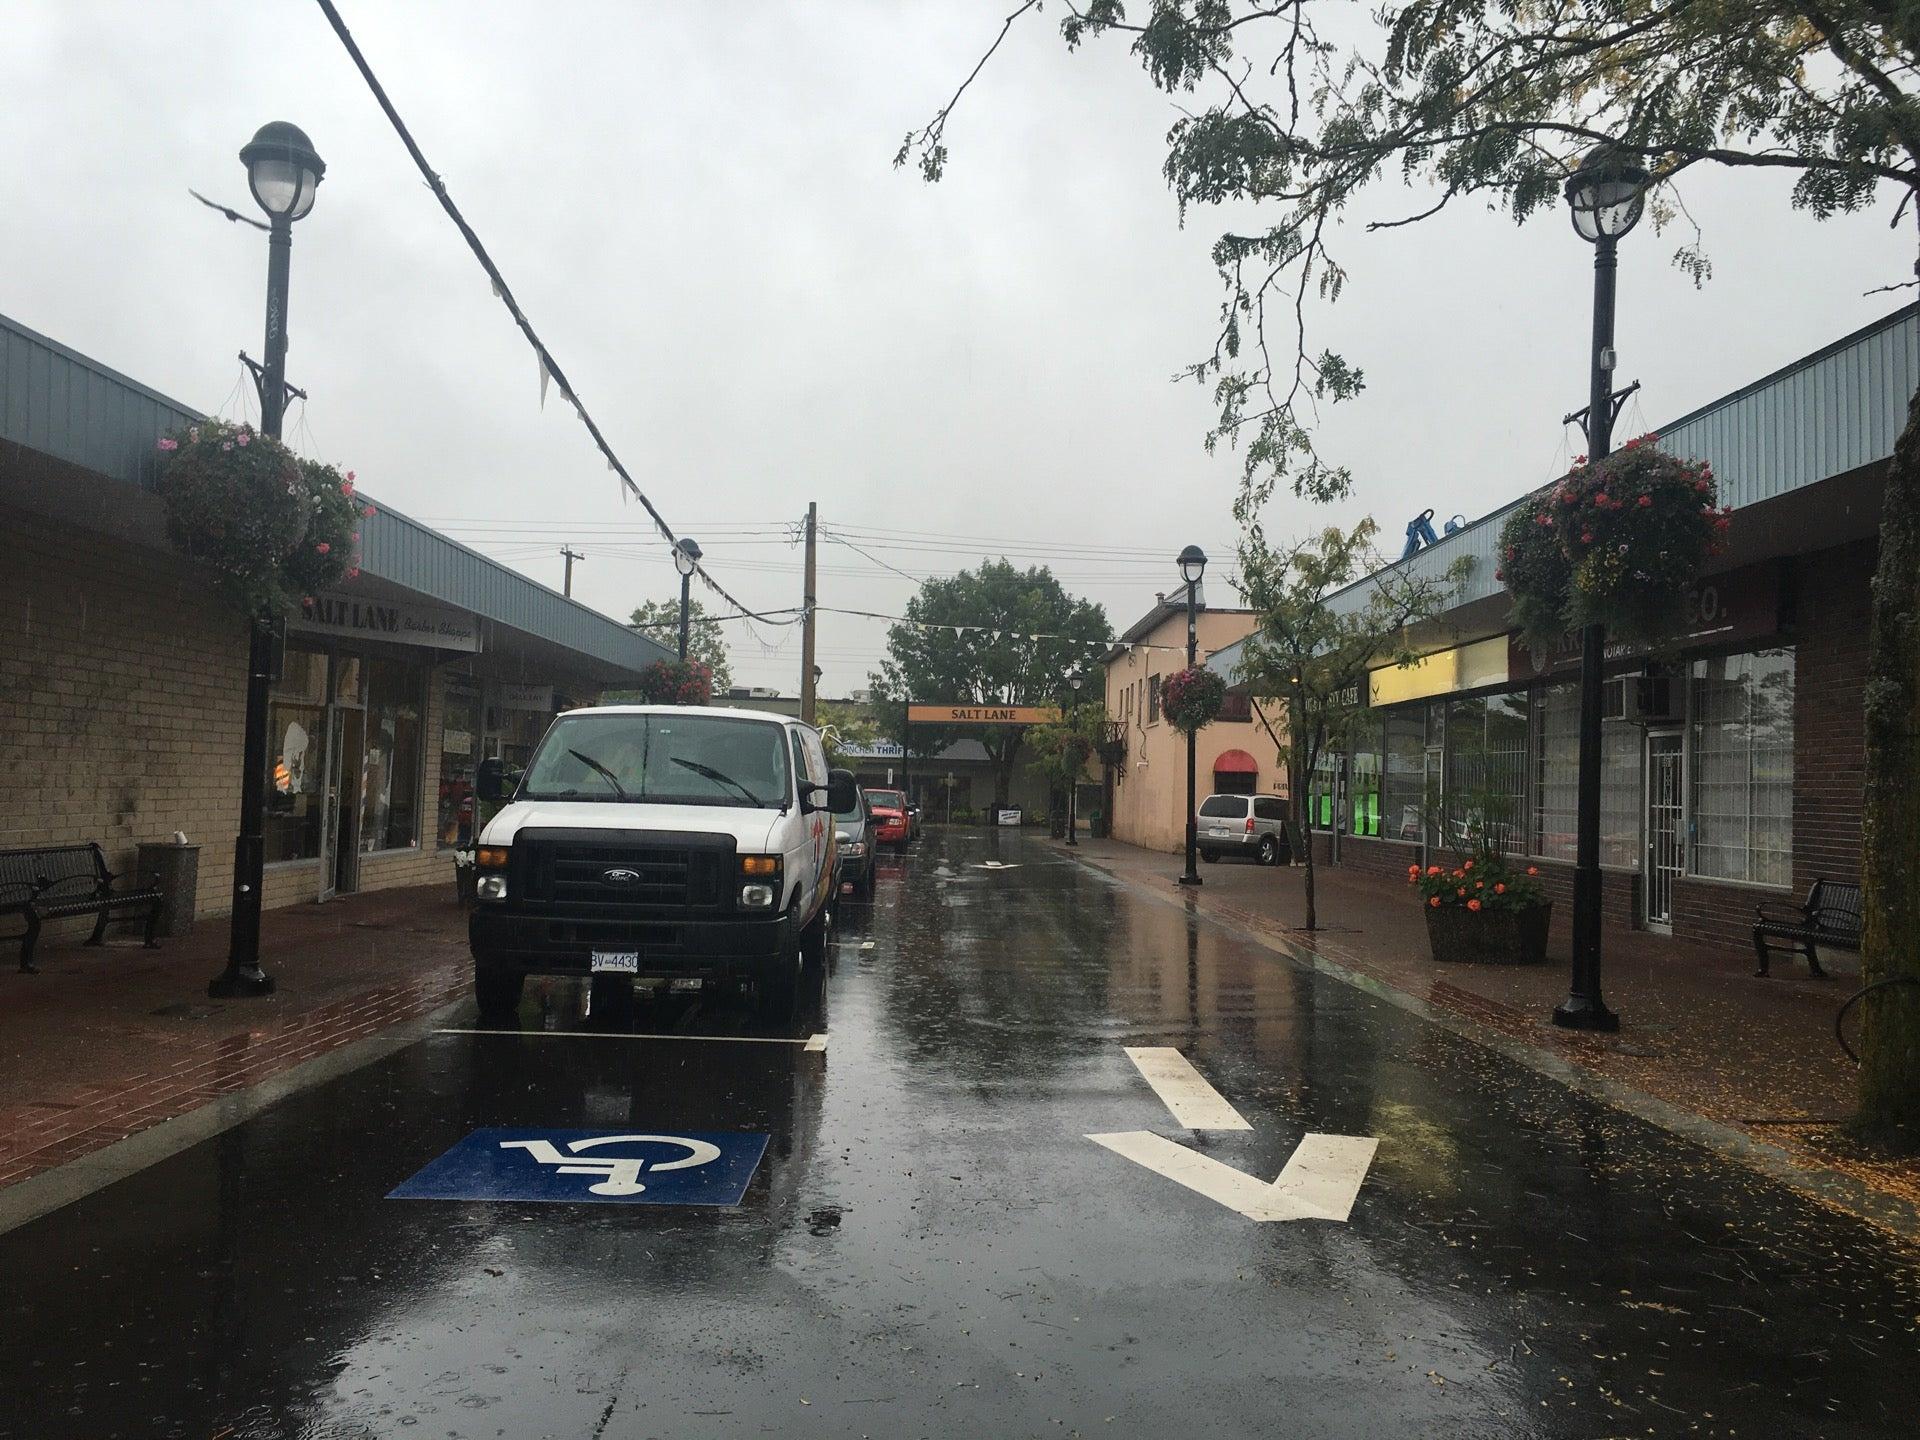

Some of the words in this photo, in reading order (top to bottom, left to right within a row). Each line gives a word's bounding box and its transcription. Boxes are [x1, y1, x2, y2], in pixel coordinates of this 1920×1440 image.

[352, 603, 400, 632] LANE
[951, 709, 982, 719] SALT
[984, 709, 1016, 720] LANE
[876, 746, 903, 755] THRIF
[609, 871, 632, 881] Ford
